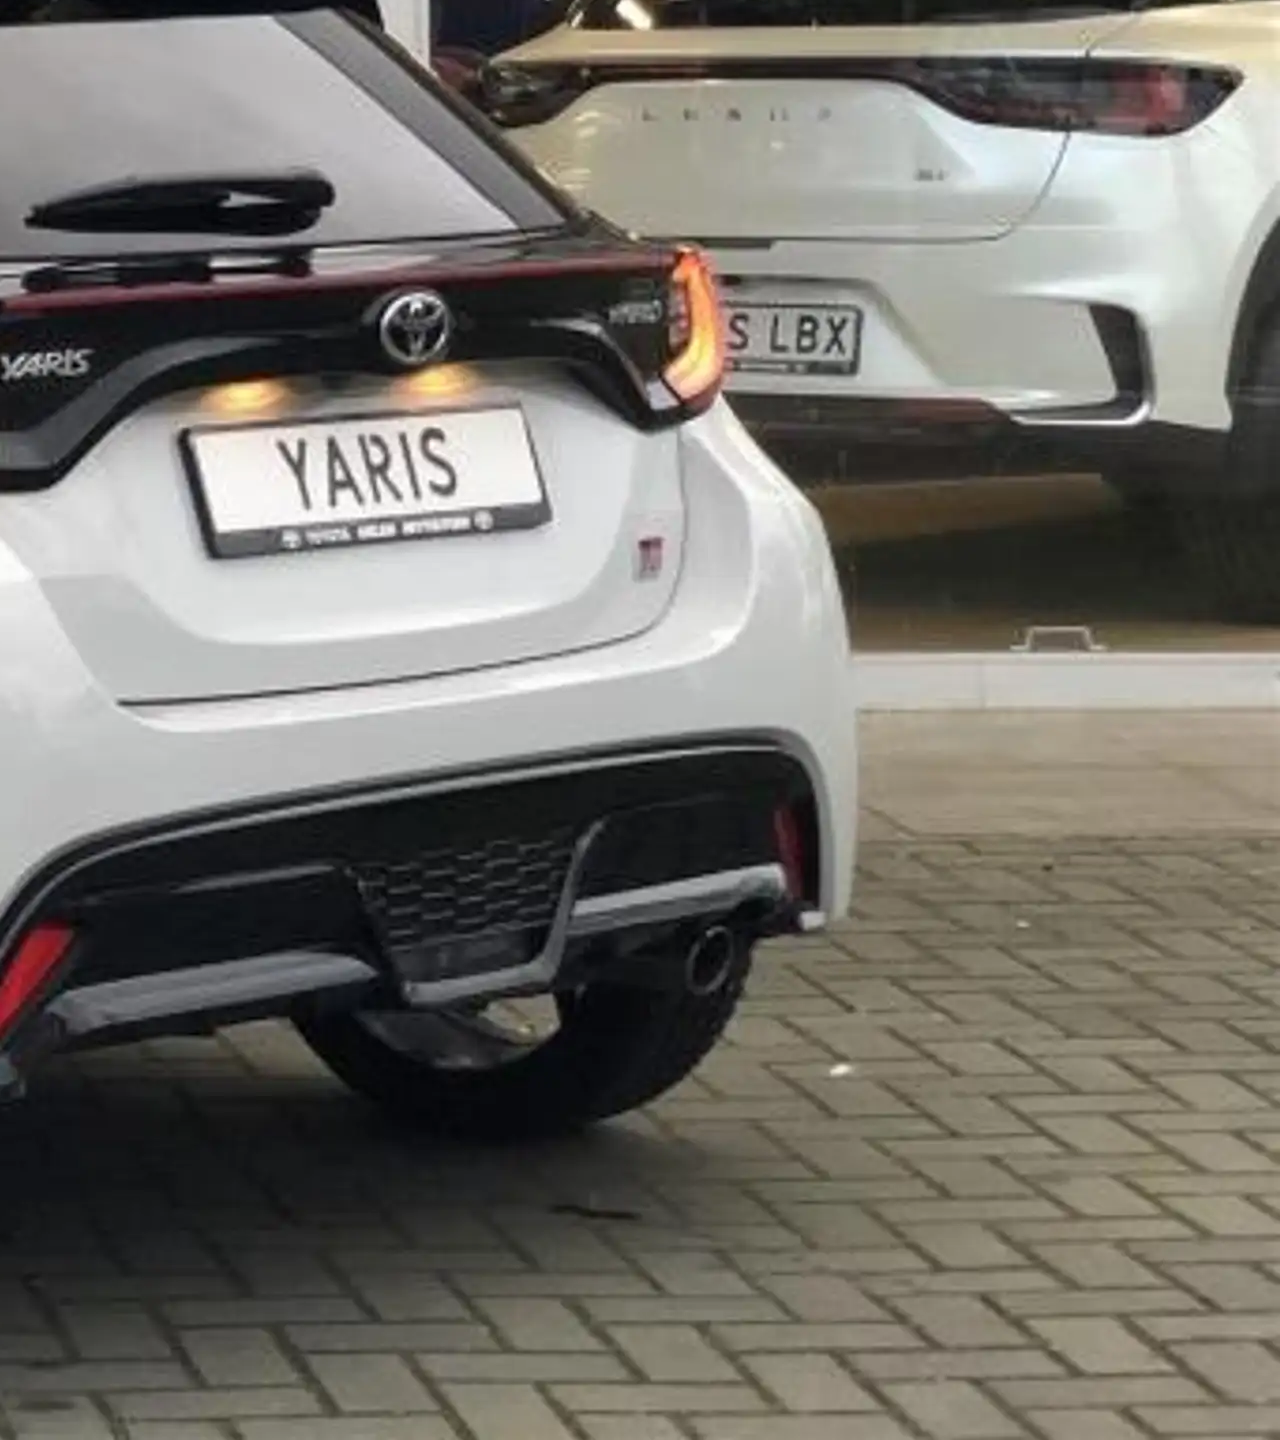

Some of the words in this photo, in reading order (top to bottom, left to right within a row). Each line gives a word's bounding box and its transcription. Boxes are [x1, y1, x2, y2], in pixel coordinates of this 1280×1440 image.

[769, 313, 849, 356] LBX
[0, 347, 96, 381] YARIS
[276, 426, 457, 511] YARIS
